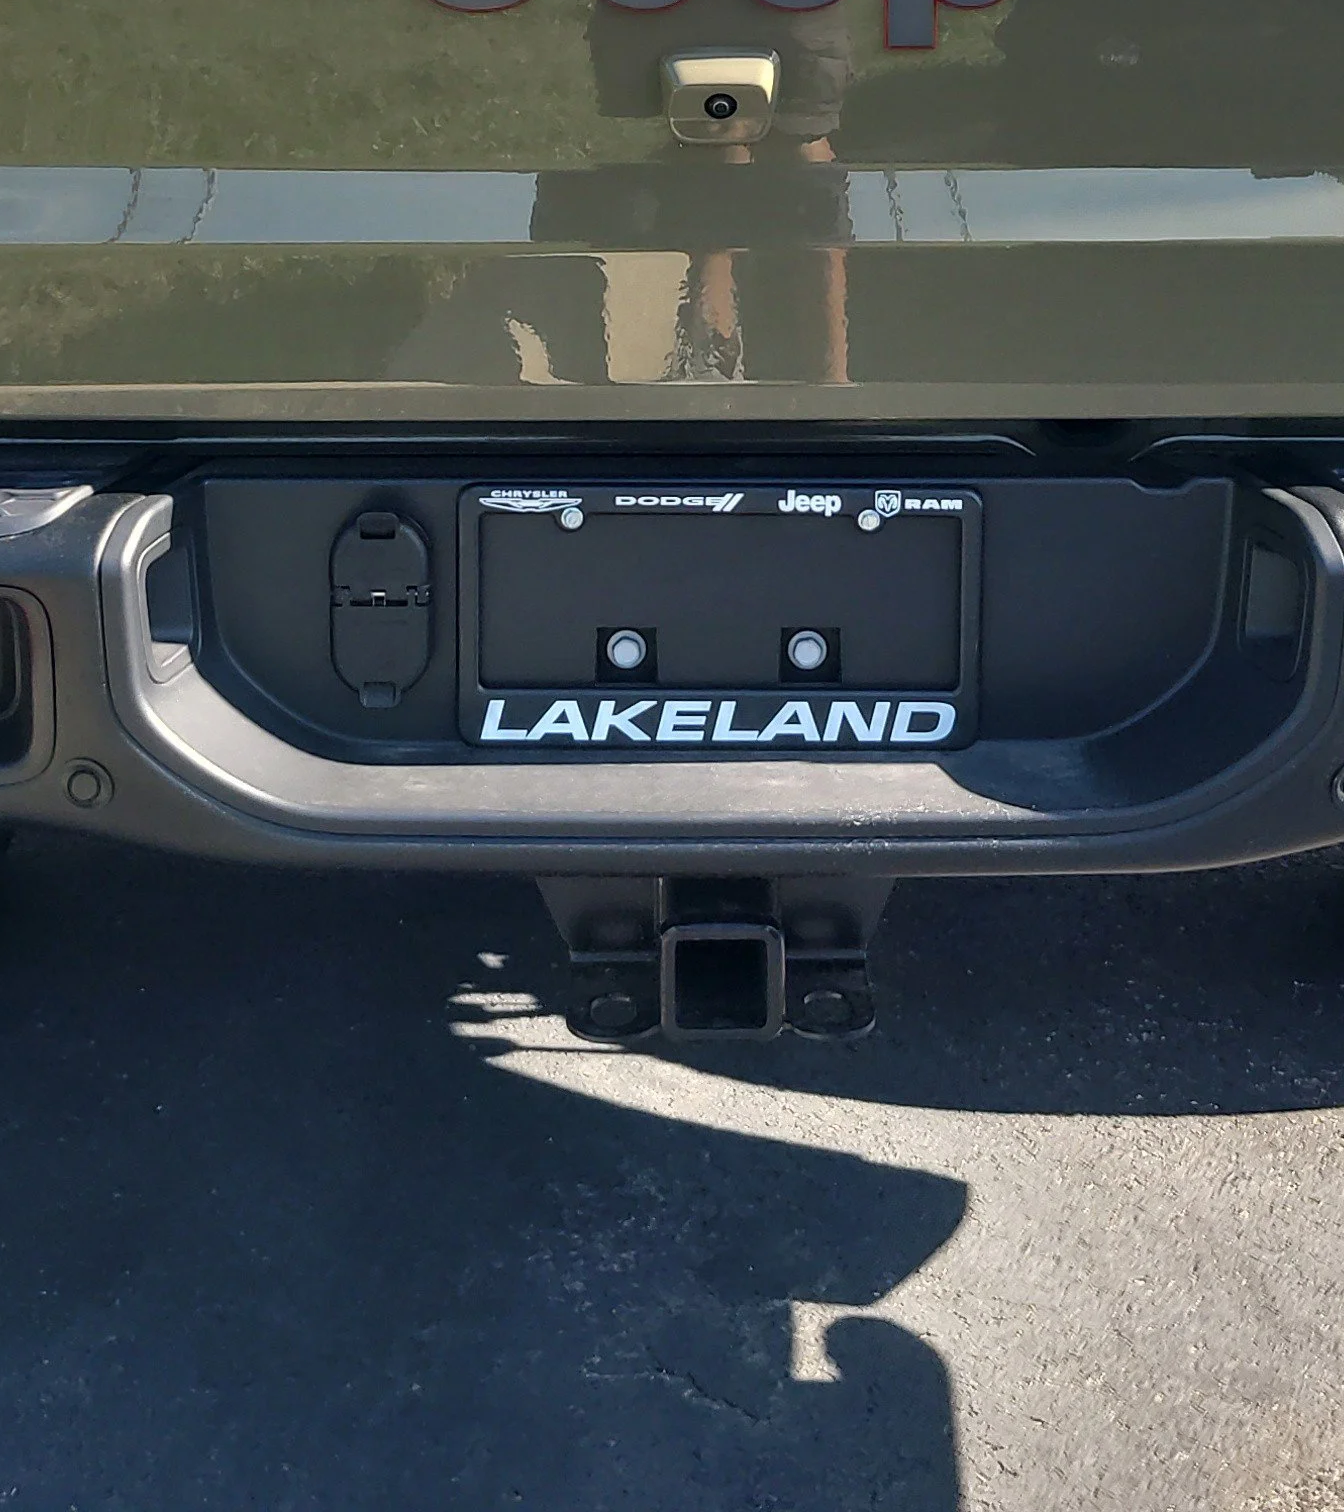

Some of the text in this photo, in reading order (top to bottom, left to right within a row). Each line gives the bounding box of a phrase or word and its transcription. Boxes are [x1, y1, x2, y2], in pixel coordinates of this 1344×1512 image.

[491, 490, 567, 498] CHRYSLER
[615, 496, 724, 506] DODGE
[778, 490, 842, 516] Jeep
[905, 499, 963, 510] RAM
[480, 699, 956, 741] LAKELAND
